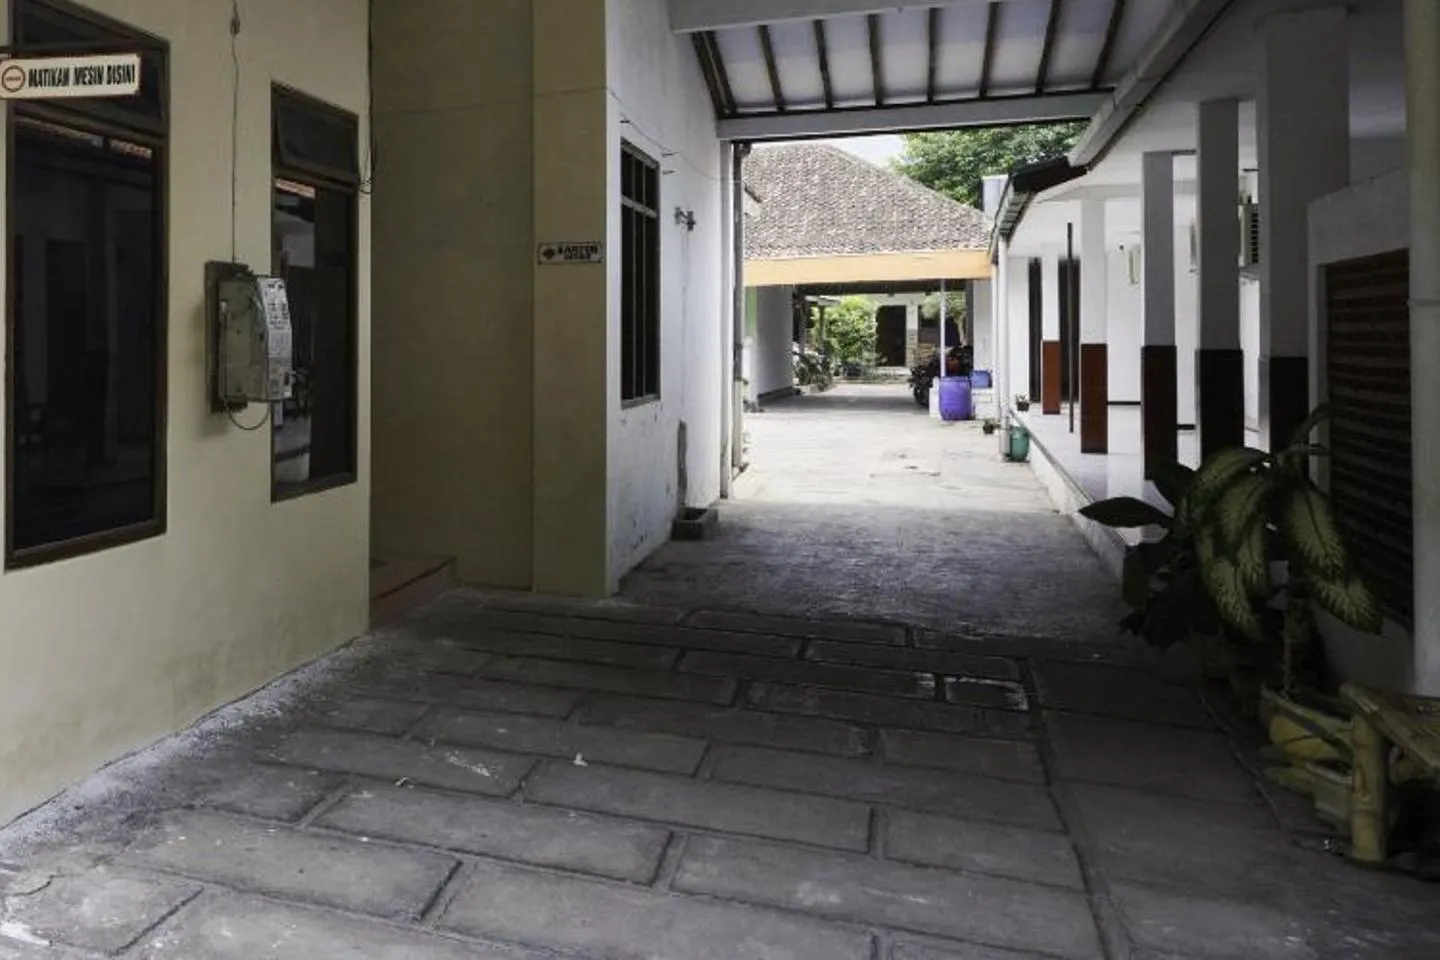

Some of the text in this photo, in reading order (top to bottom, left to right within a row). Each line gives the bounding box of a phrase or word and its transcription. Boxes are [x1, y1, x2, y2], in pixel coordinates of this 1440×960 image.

[28, 63, 136, 87] MATIKAN MESIN DISINI
